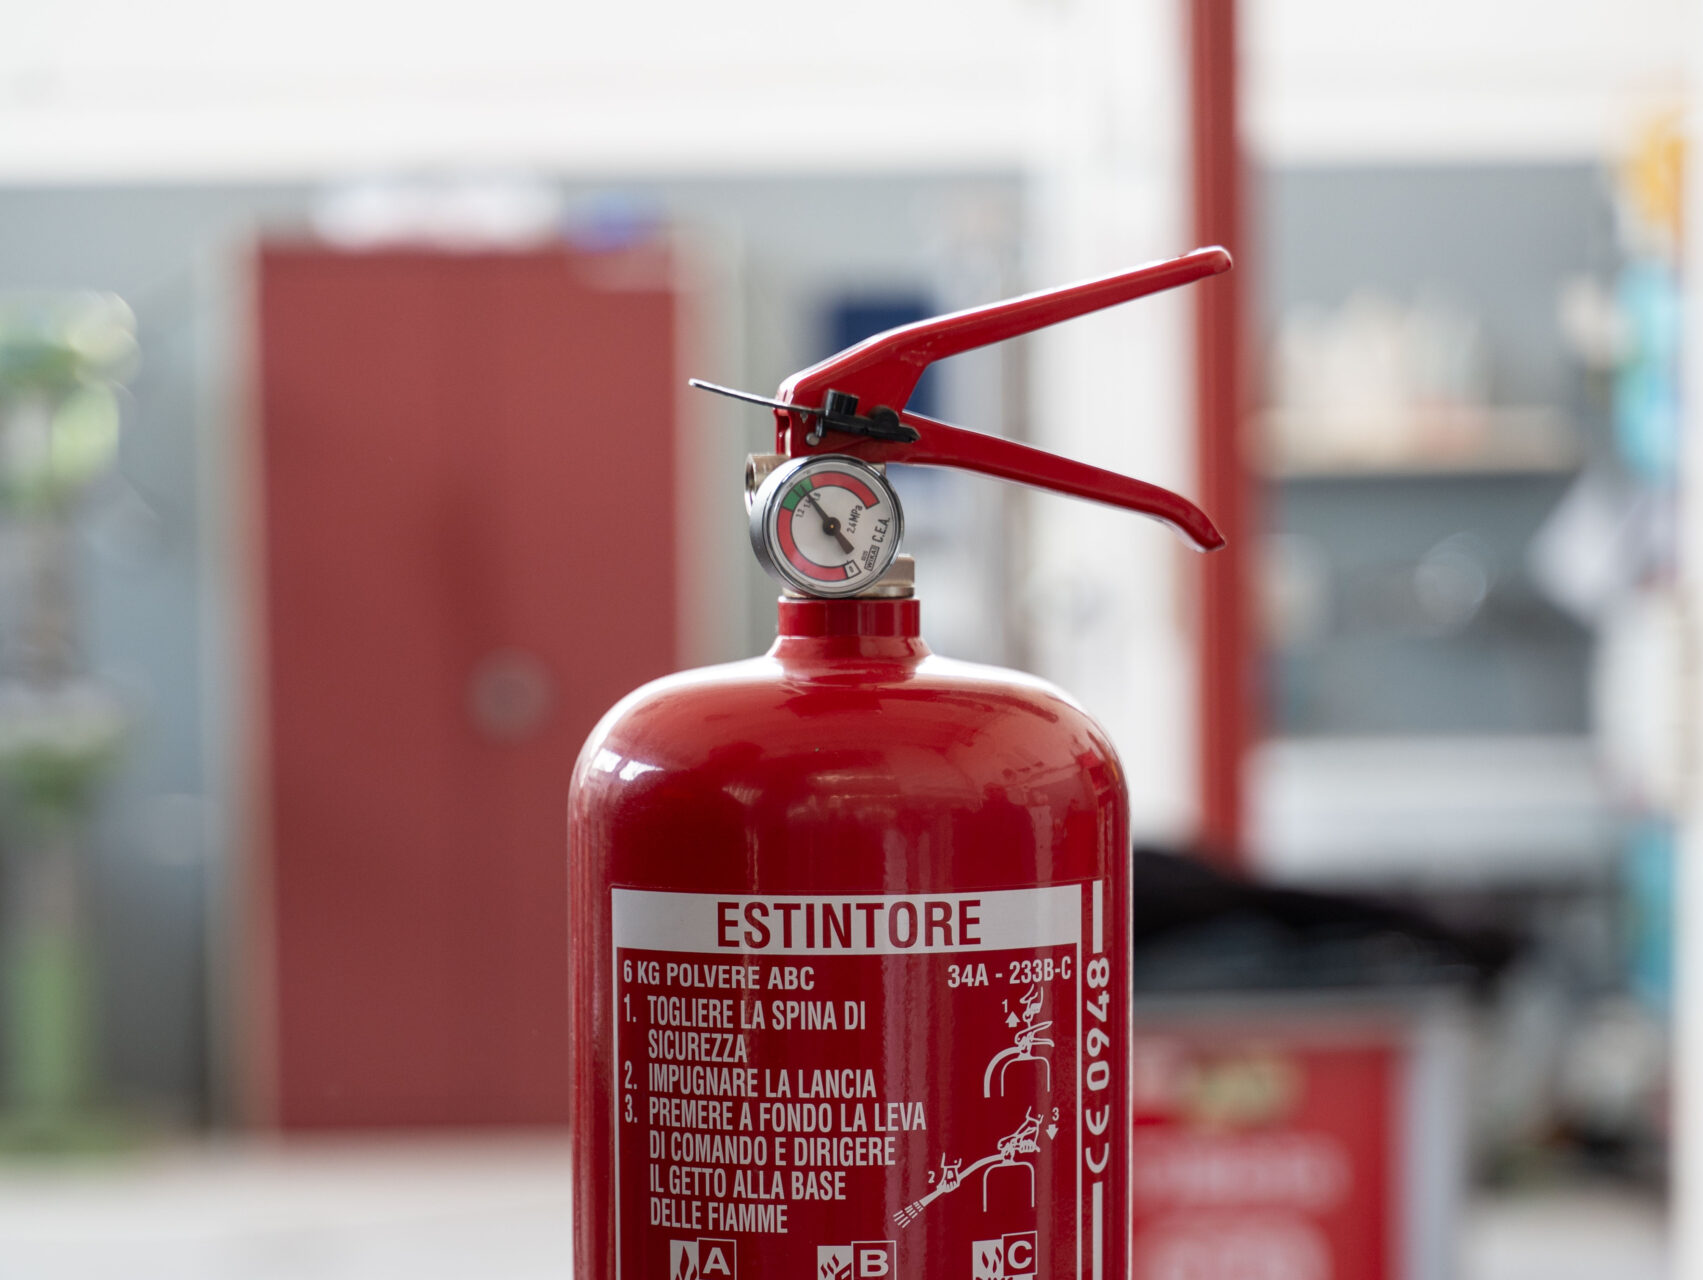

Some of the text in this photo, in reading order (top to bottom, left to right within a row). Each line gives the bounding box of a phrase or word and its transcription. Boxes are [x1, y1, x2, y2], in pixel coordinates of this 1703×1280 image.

[872, 517, 890, 543] C.E.A.
[717, 899, 981, 949] ESTINTORE
[623, 960, 815, 991] 6 KG POLVERE ABC
[948, 963, 989, 988] 34A
[1009, 955, 1071, 985] 233B-C
[624, 993, 866, 1031] 1. TOGLIERE LA SPINA DI
[1002, 1000, 1009, 1012] 1
[1087, 957, 1111, 1091] 0948
[648, 1029, 747, 1063] SICUREZZA
[625, 1060, 876, 1099] 2. IMPUGNARE LA LANCIA
[624, 1094, 926, 1133] 3. PREMERE A FONDO LA LEVA
[1052, 1106, 1059, 1121] 3
[649, 1131, 896, 1167] DI COMANDO E DIRIGERE
[649, 1163, 846, 1201] IL GETTO ALLA BASE
[928, 1171, 935, 1184] 2
[650, 1197, 789, 1234] DELLE FIAMME
[702, 1247, 731, 1276] A
[859, 1249, 889, 1278] B
[1007, 1240, 1033, 1267] C
